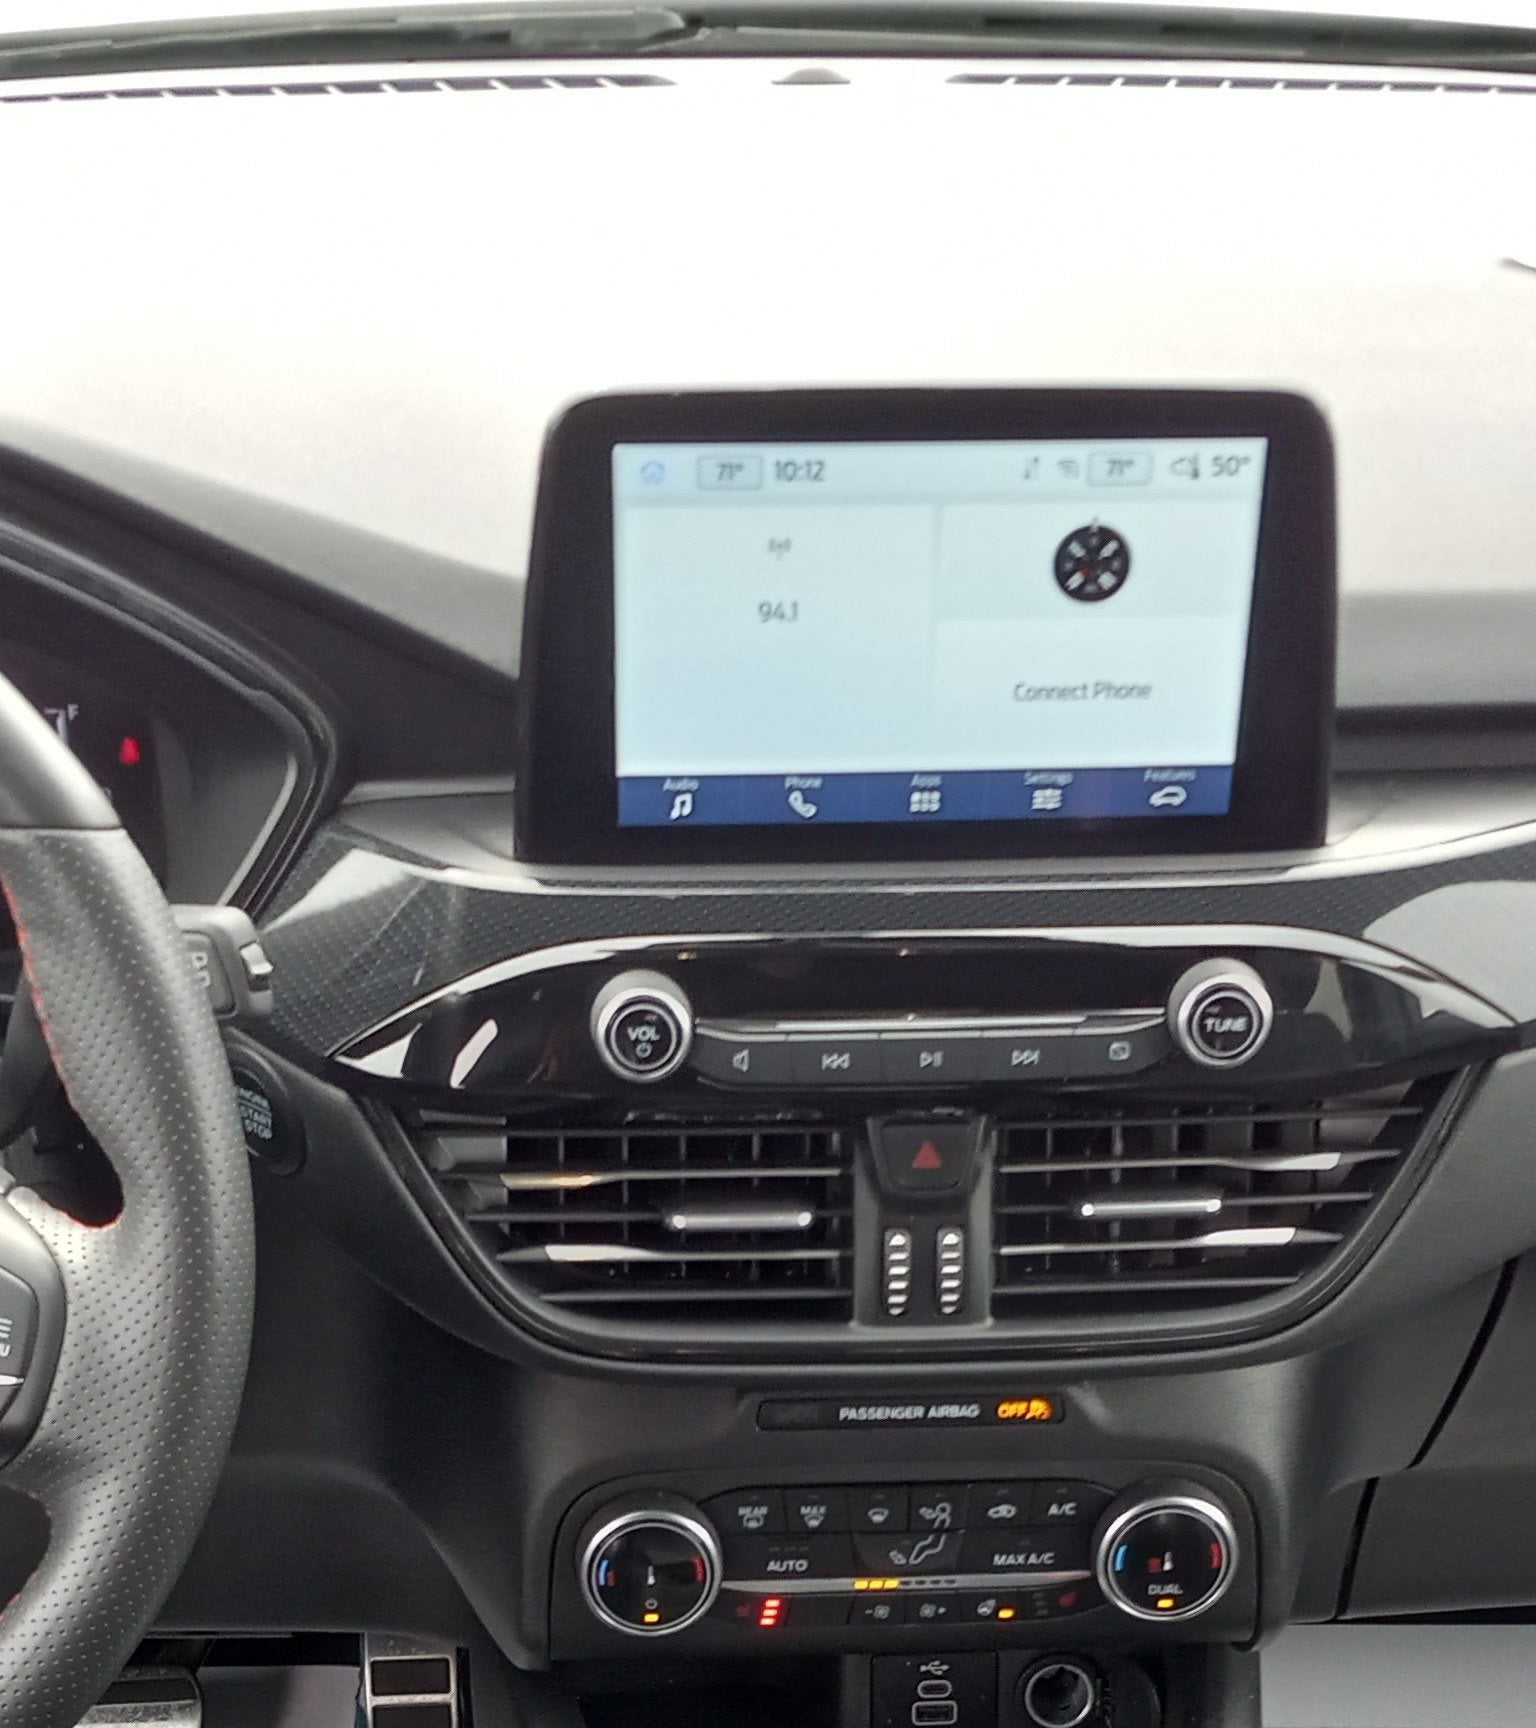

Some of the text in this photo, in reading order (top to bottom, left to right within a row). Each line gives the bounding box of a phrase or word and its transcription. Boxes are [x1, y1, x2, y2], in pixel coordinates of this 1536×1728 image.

[775, 459, 825, 482] 10:12
[757, 600, 800, 624] 94.1
[1013, 680, 1153, 702] Connect Phone
[627, 1025, 661, 1042] VOL
[1205, 1016, 1247, 1034] TUNE
[839, 1405, 924, 1422] PASSENGER
[927, 1403, 982, 1419] AIRBAG
[1048, 1502, 1077, 1517] A/C
[766, 1559, 809, 1573] AUTO
[993, 1552, 1055, 1566] MAX A/C
[1148, 1585, 1183, 1597] DUAL
